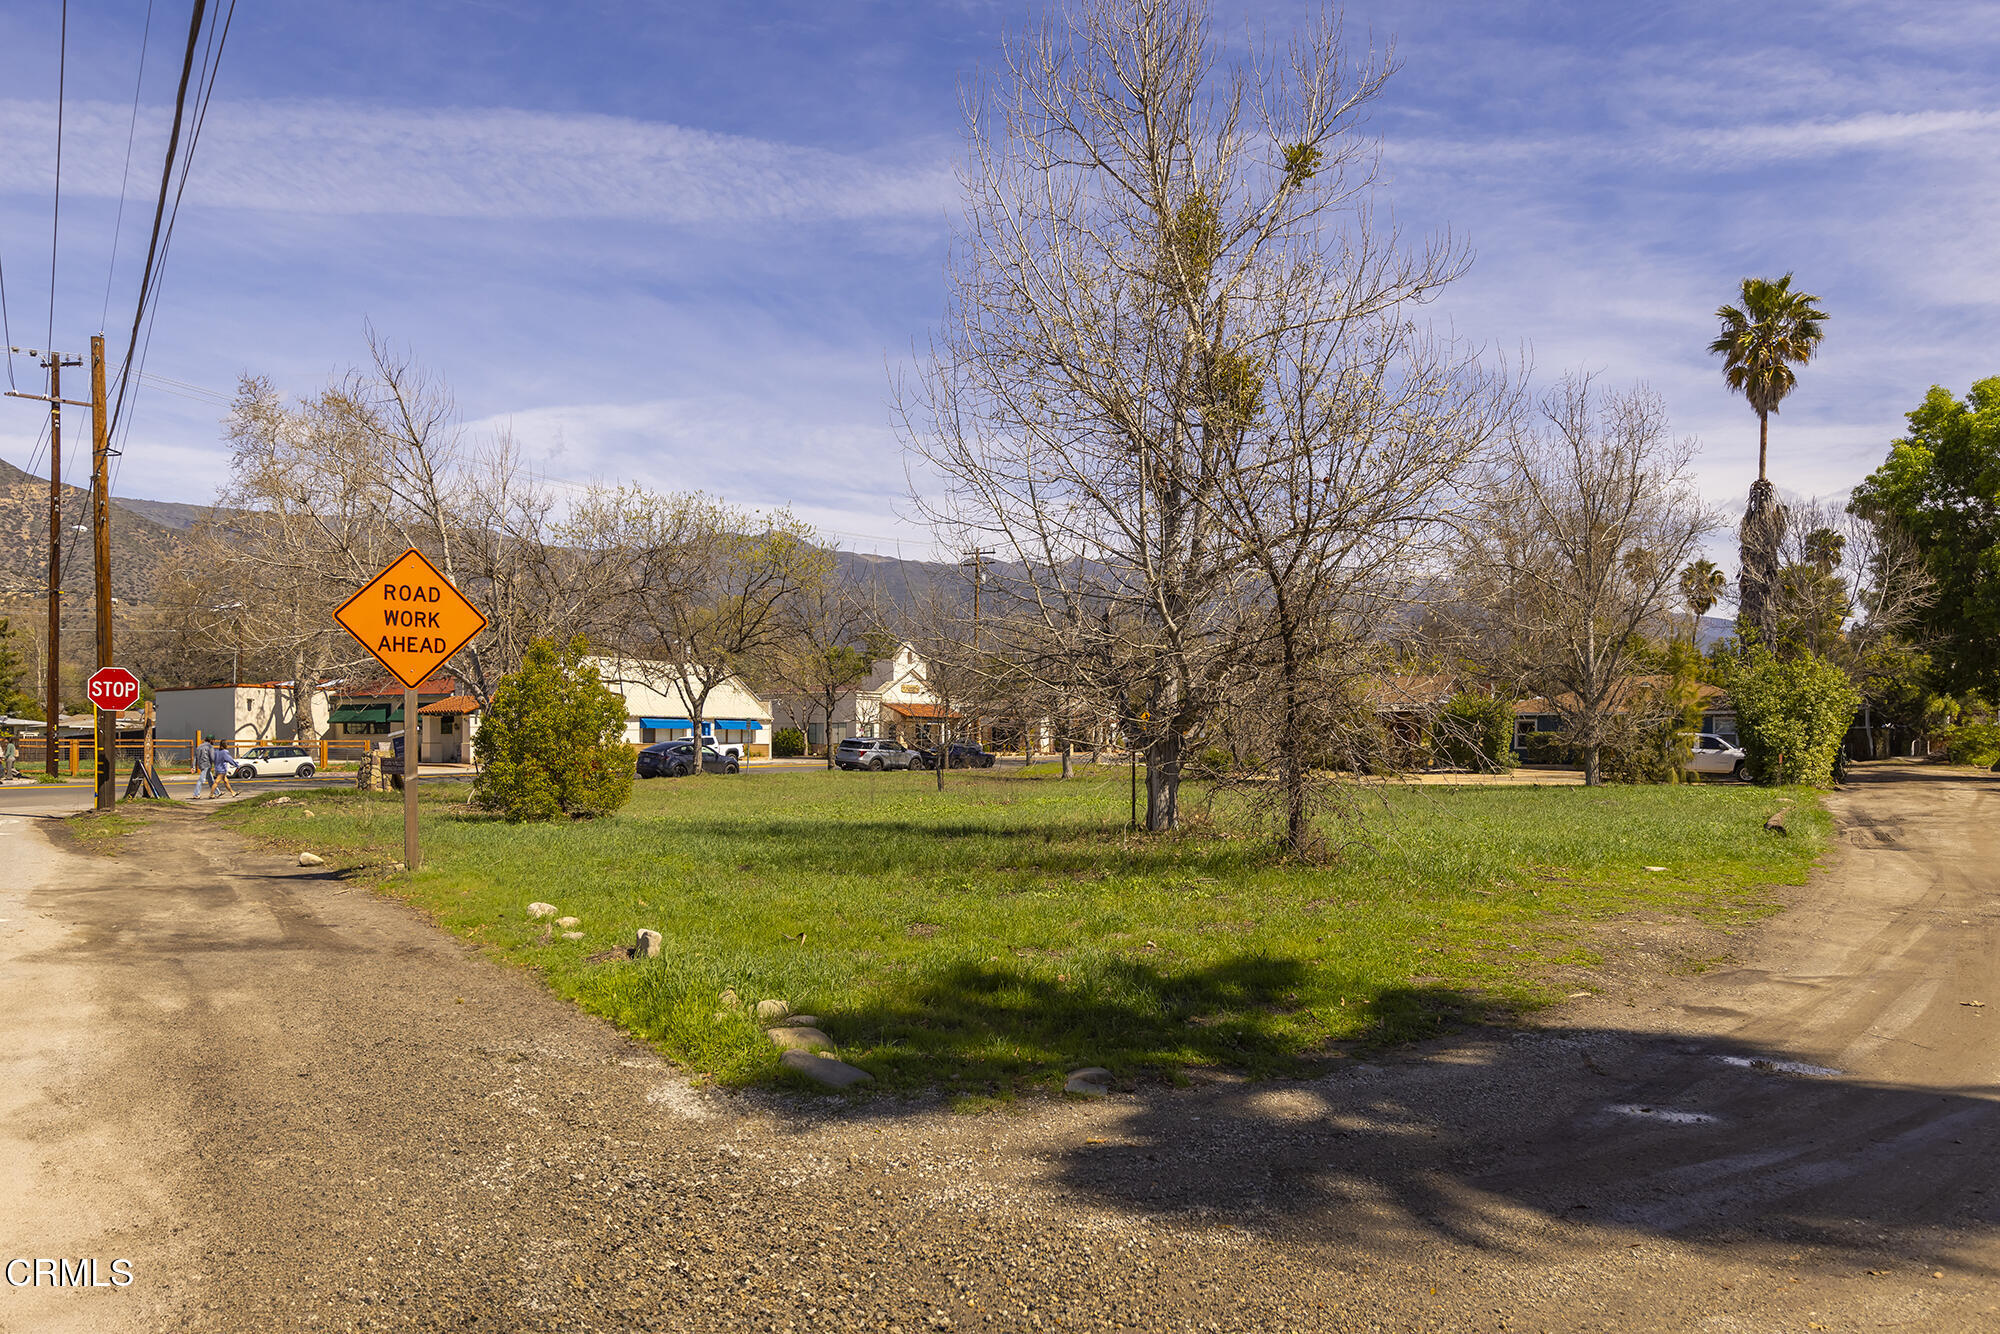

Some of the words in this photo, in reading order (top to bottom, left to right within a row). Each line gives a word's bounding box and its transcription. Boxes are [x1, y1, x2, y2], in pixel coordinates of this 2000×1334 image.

[384, 584, 441, 603] ROAD
[384, 609, 440, 628] WORK
[377, 635, 447, 654] AHEAD
[91, 681, 136, 698] STOP
